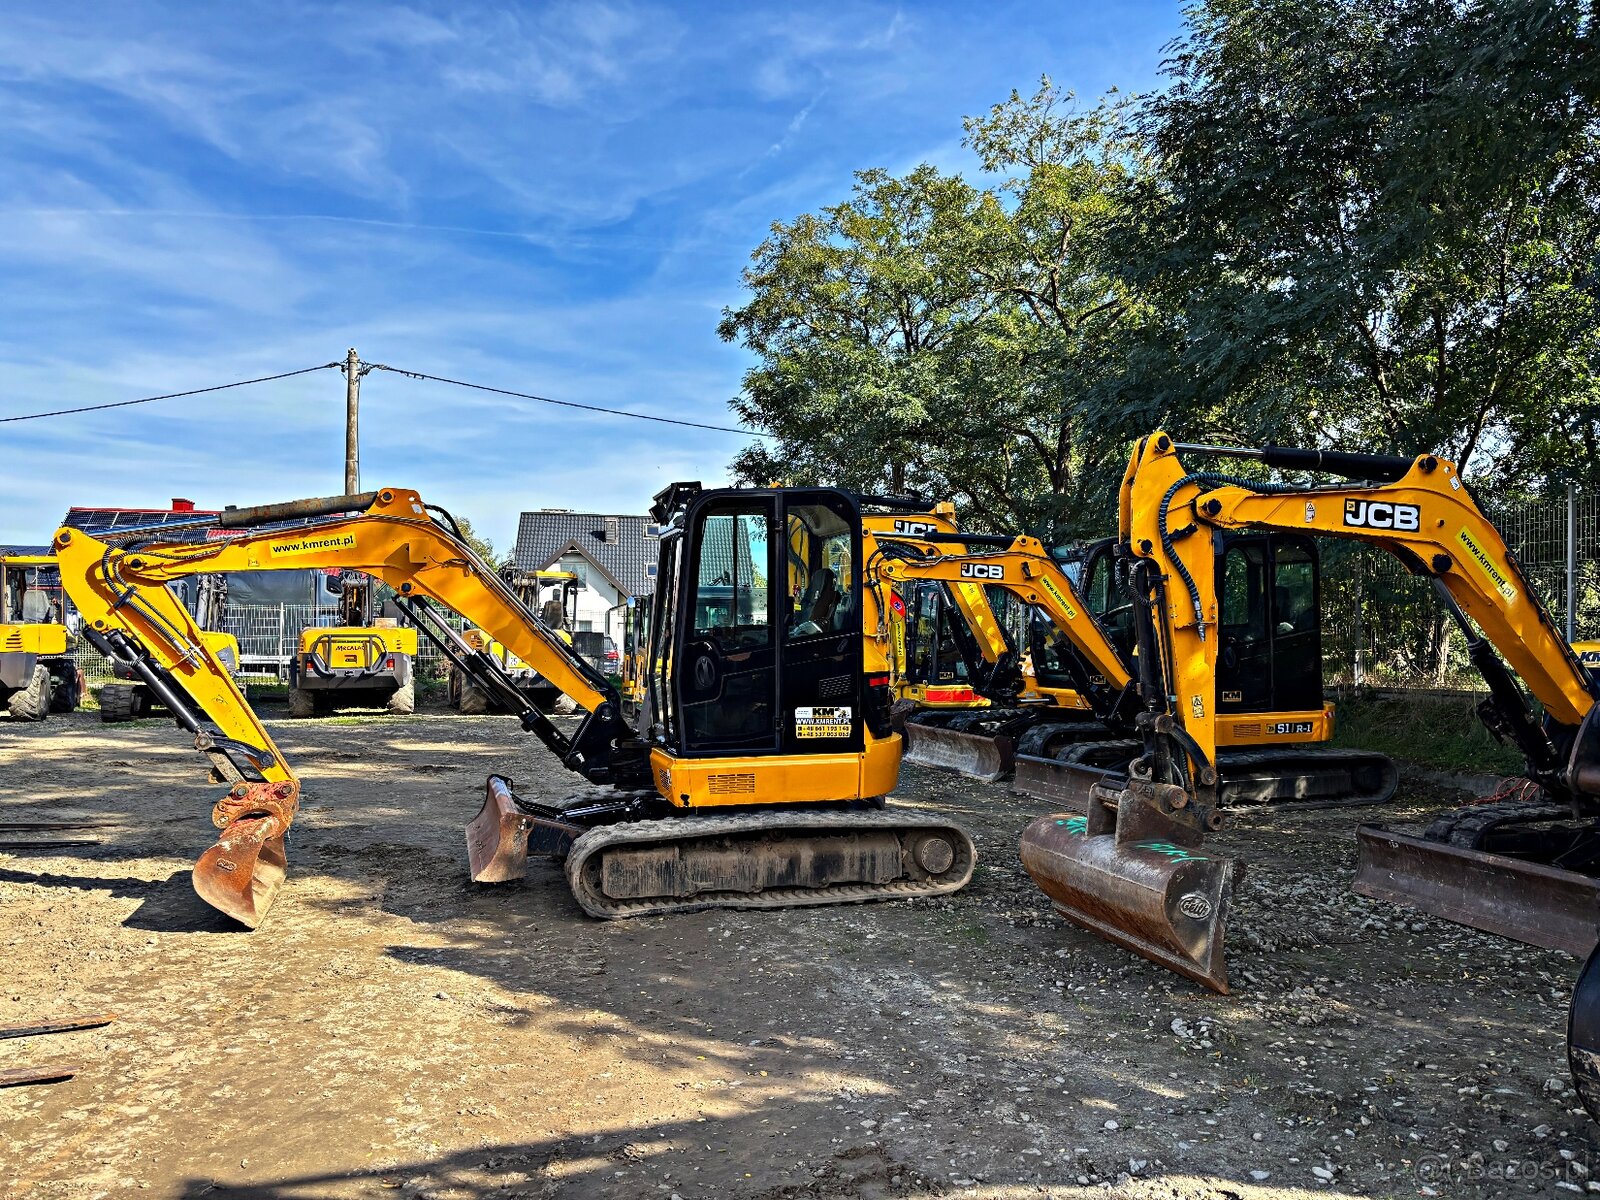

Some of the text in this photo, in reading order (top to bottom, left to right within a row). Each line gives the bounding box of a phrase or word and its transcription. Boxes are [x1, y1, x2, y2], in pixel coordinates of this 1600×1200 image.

[1345, 502, 1418, 530] JCB
[272, 535, 354, 553] www.kmrent.pl
[961, 564, 1003, 578] JCB
[1460, 531, 1515, 597] www.kmrent.pl
[812, 708, 835, 716] KM
